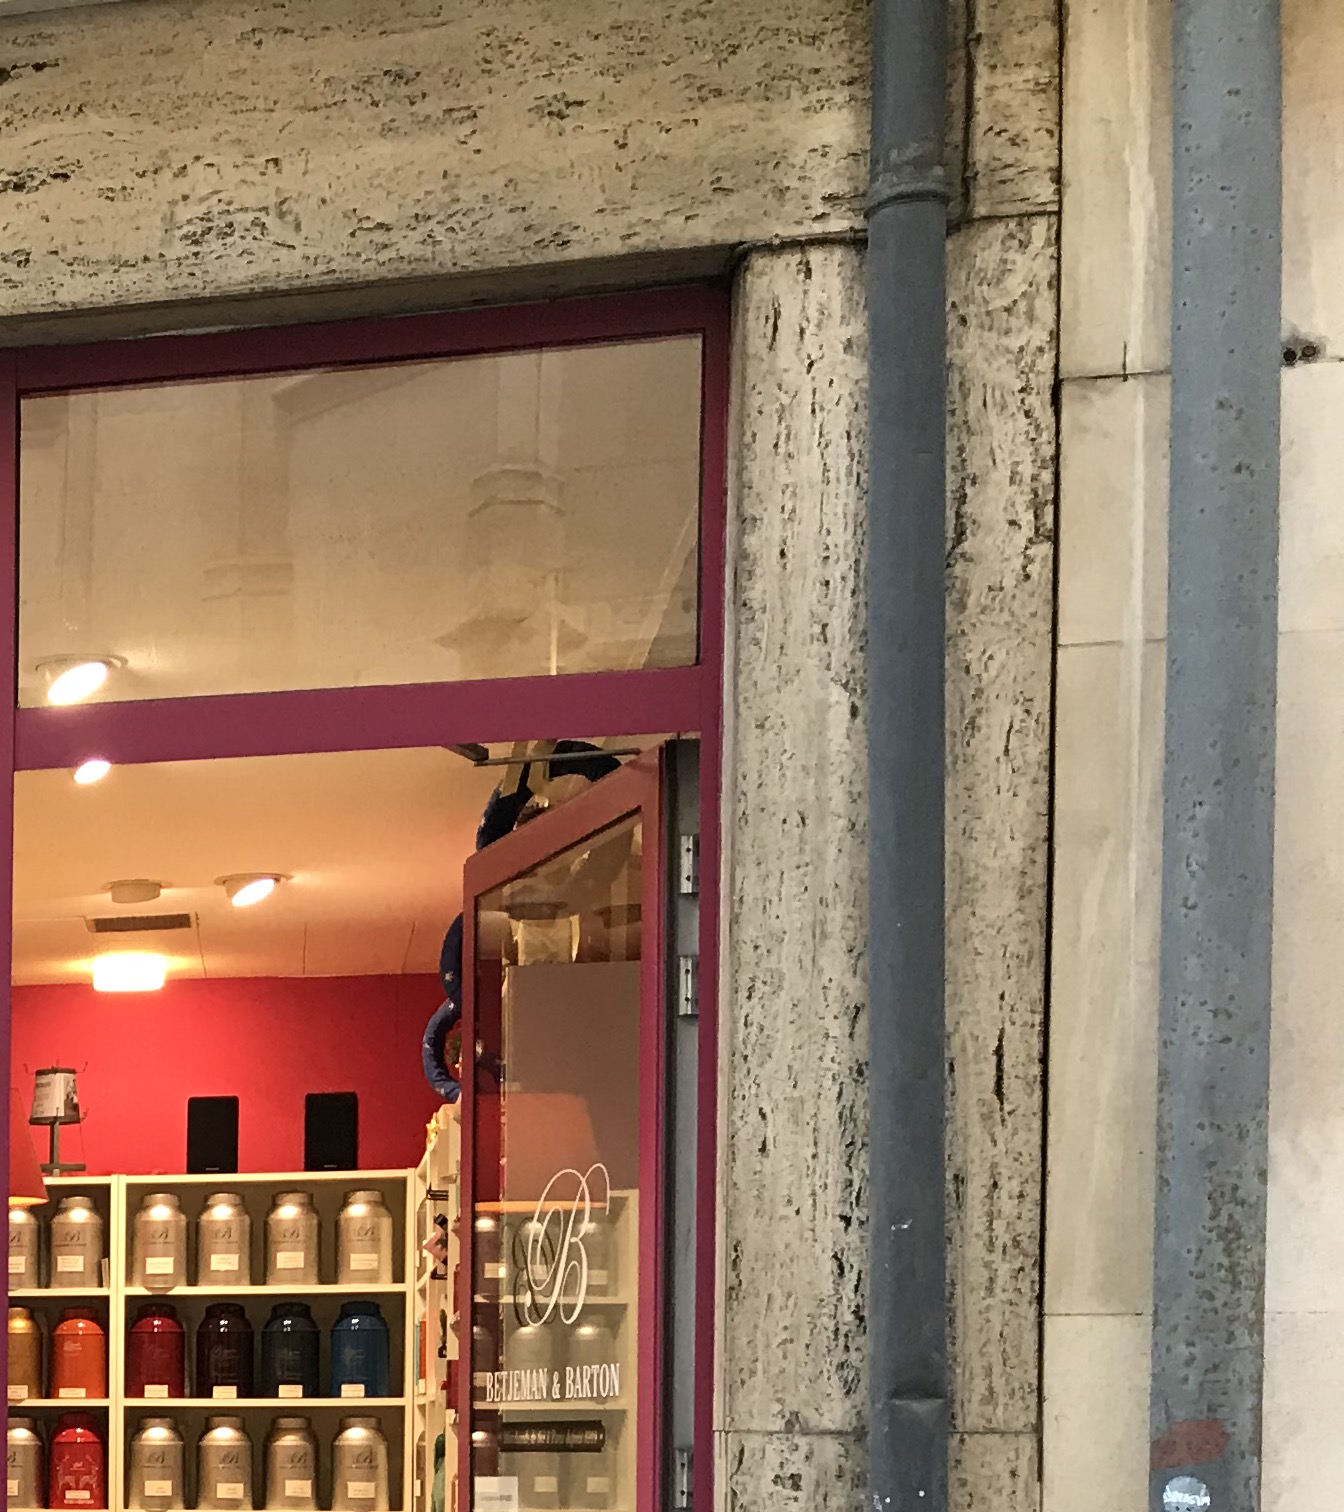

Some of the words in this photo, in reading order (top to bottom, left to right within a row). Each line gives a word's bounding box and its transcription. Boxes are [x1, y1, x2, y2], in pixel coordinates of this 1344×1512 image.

[485, 1367, 548, 1402] BETJEMAN
[551, 1371, 561, 1399] &
[565, 1363, 620, 1399] BARTON
